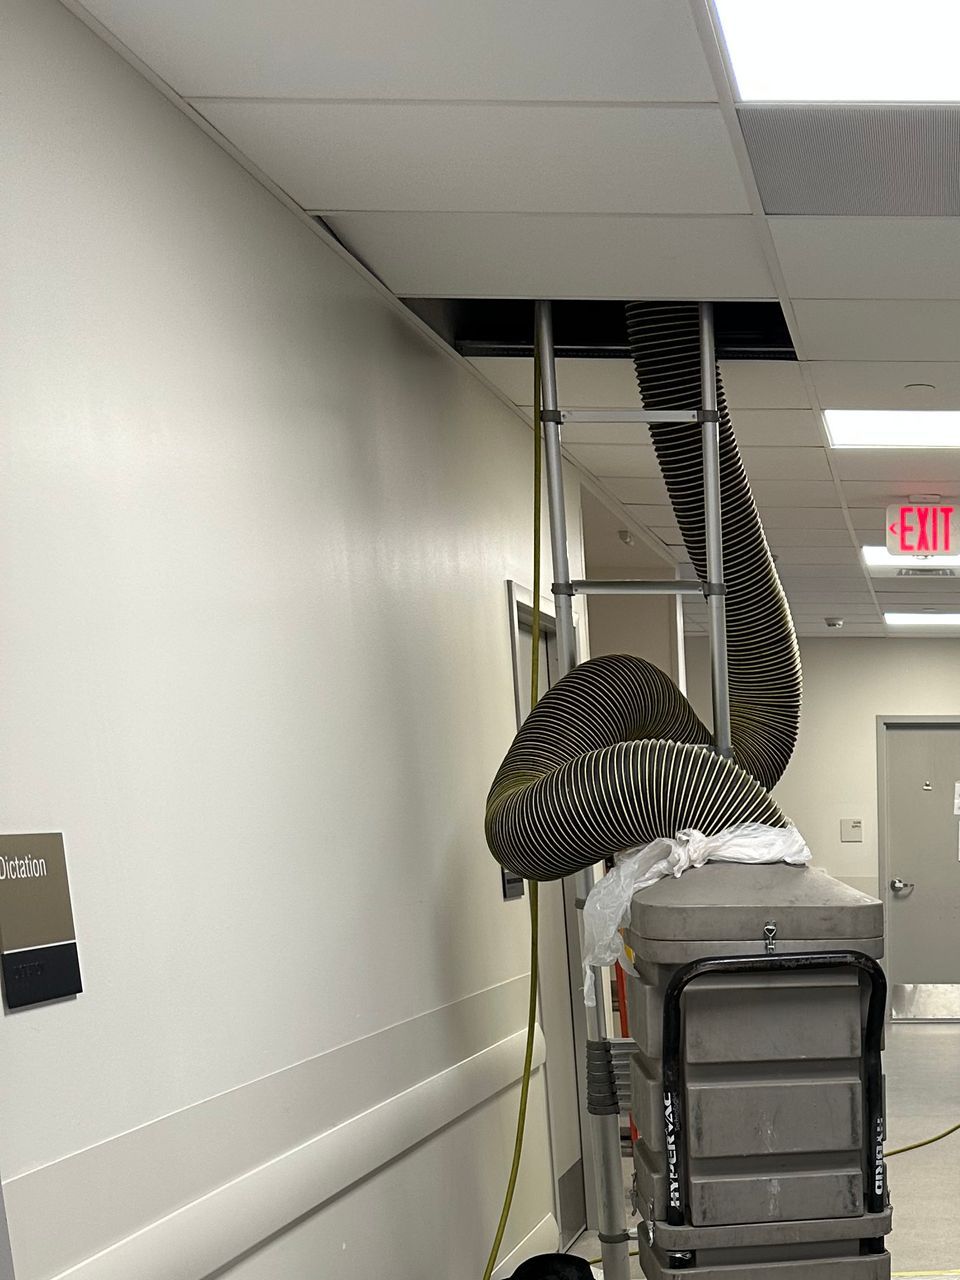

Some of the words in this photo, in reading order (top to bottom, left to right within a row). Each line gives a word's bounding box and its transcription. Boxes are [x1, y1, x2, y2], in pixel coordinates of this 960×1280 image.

[899, 506, 954, 552] EXIT
[0, 854, 47, 880] Dictation
[664, 1092, 680, 1208] HYPERVAC
[875, 1117, 884, 1195] HYBRID
